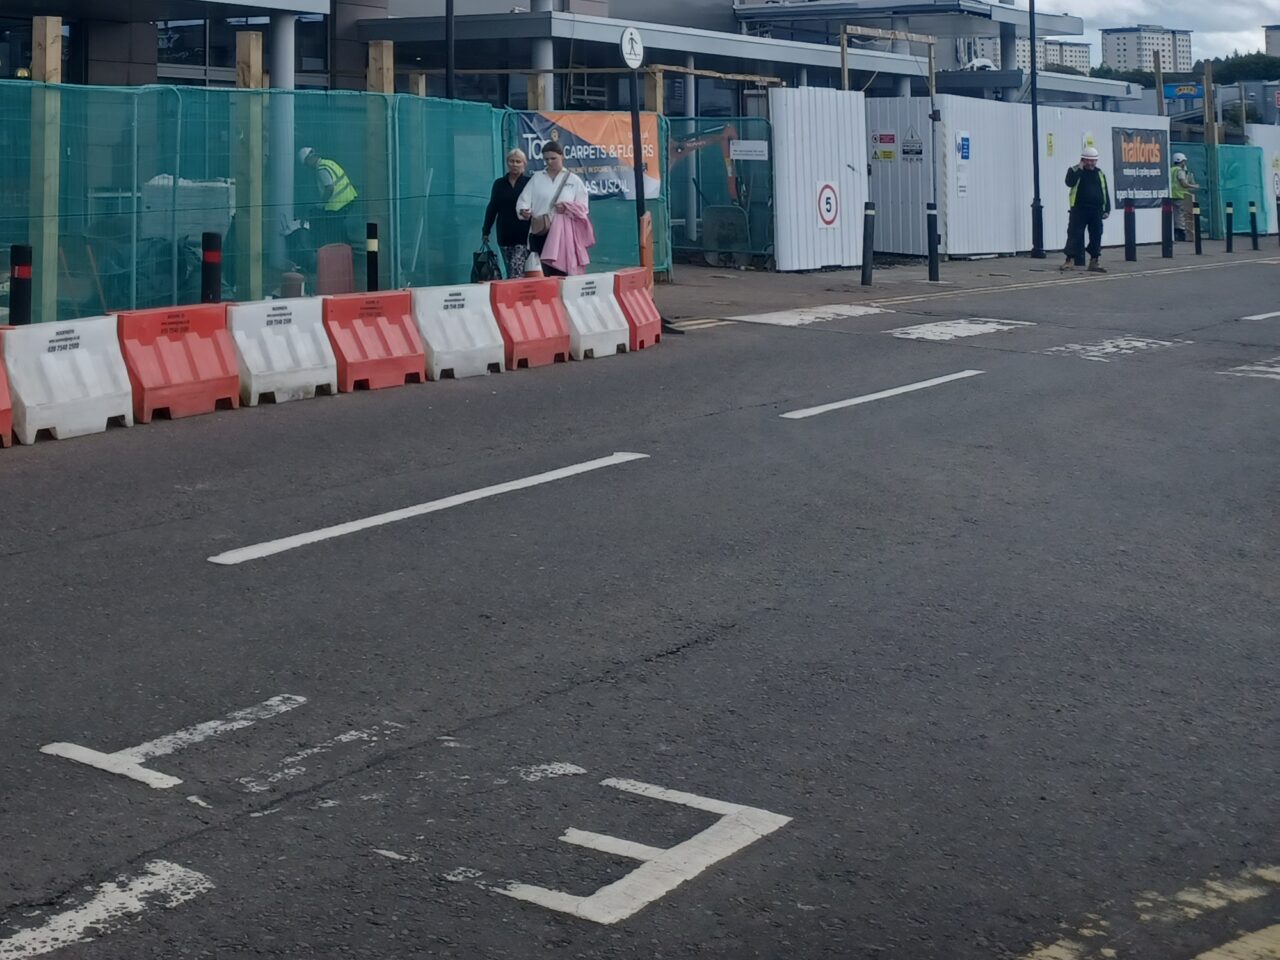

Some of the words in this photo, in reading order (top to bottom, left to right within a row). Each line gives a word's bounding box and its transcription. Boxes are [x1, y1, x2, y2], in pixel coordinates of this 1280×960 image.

[563, 144, 606, 159] CARPETS
[609, 144, 618, 158] &
[618, 143, 654, 158] FLORS
[1121, 134, 1161, 163] halfords
[825, 196, 832, 213] 5
